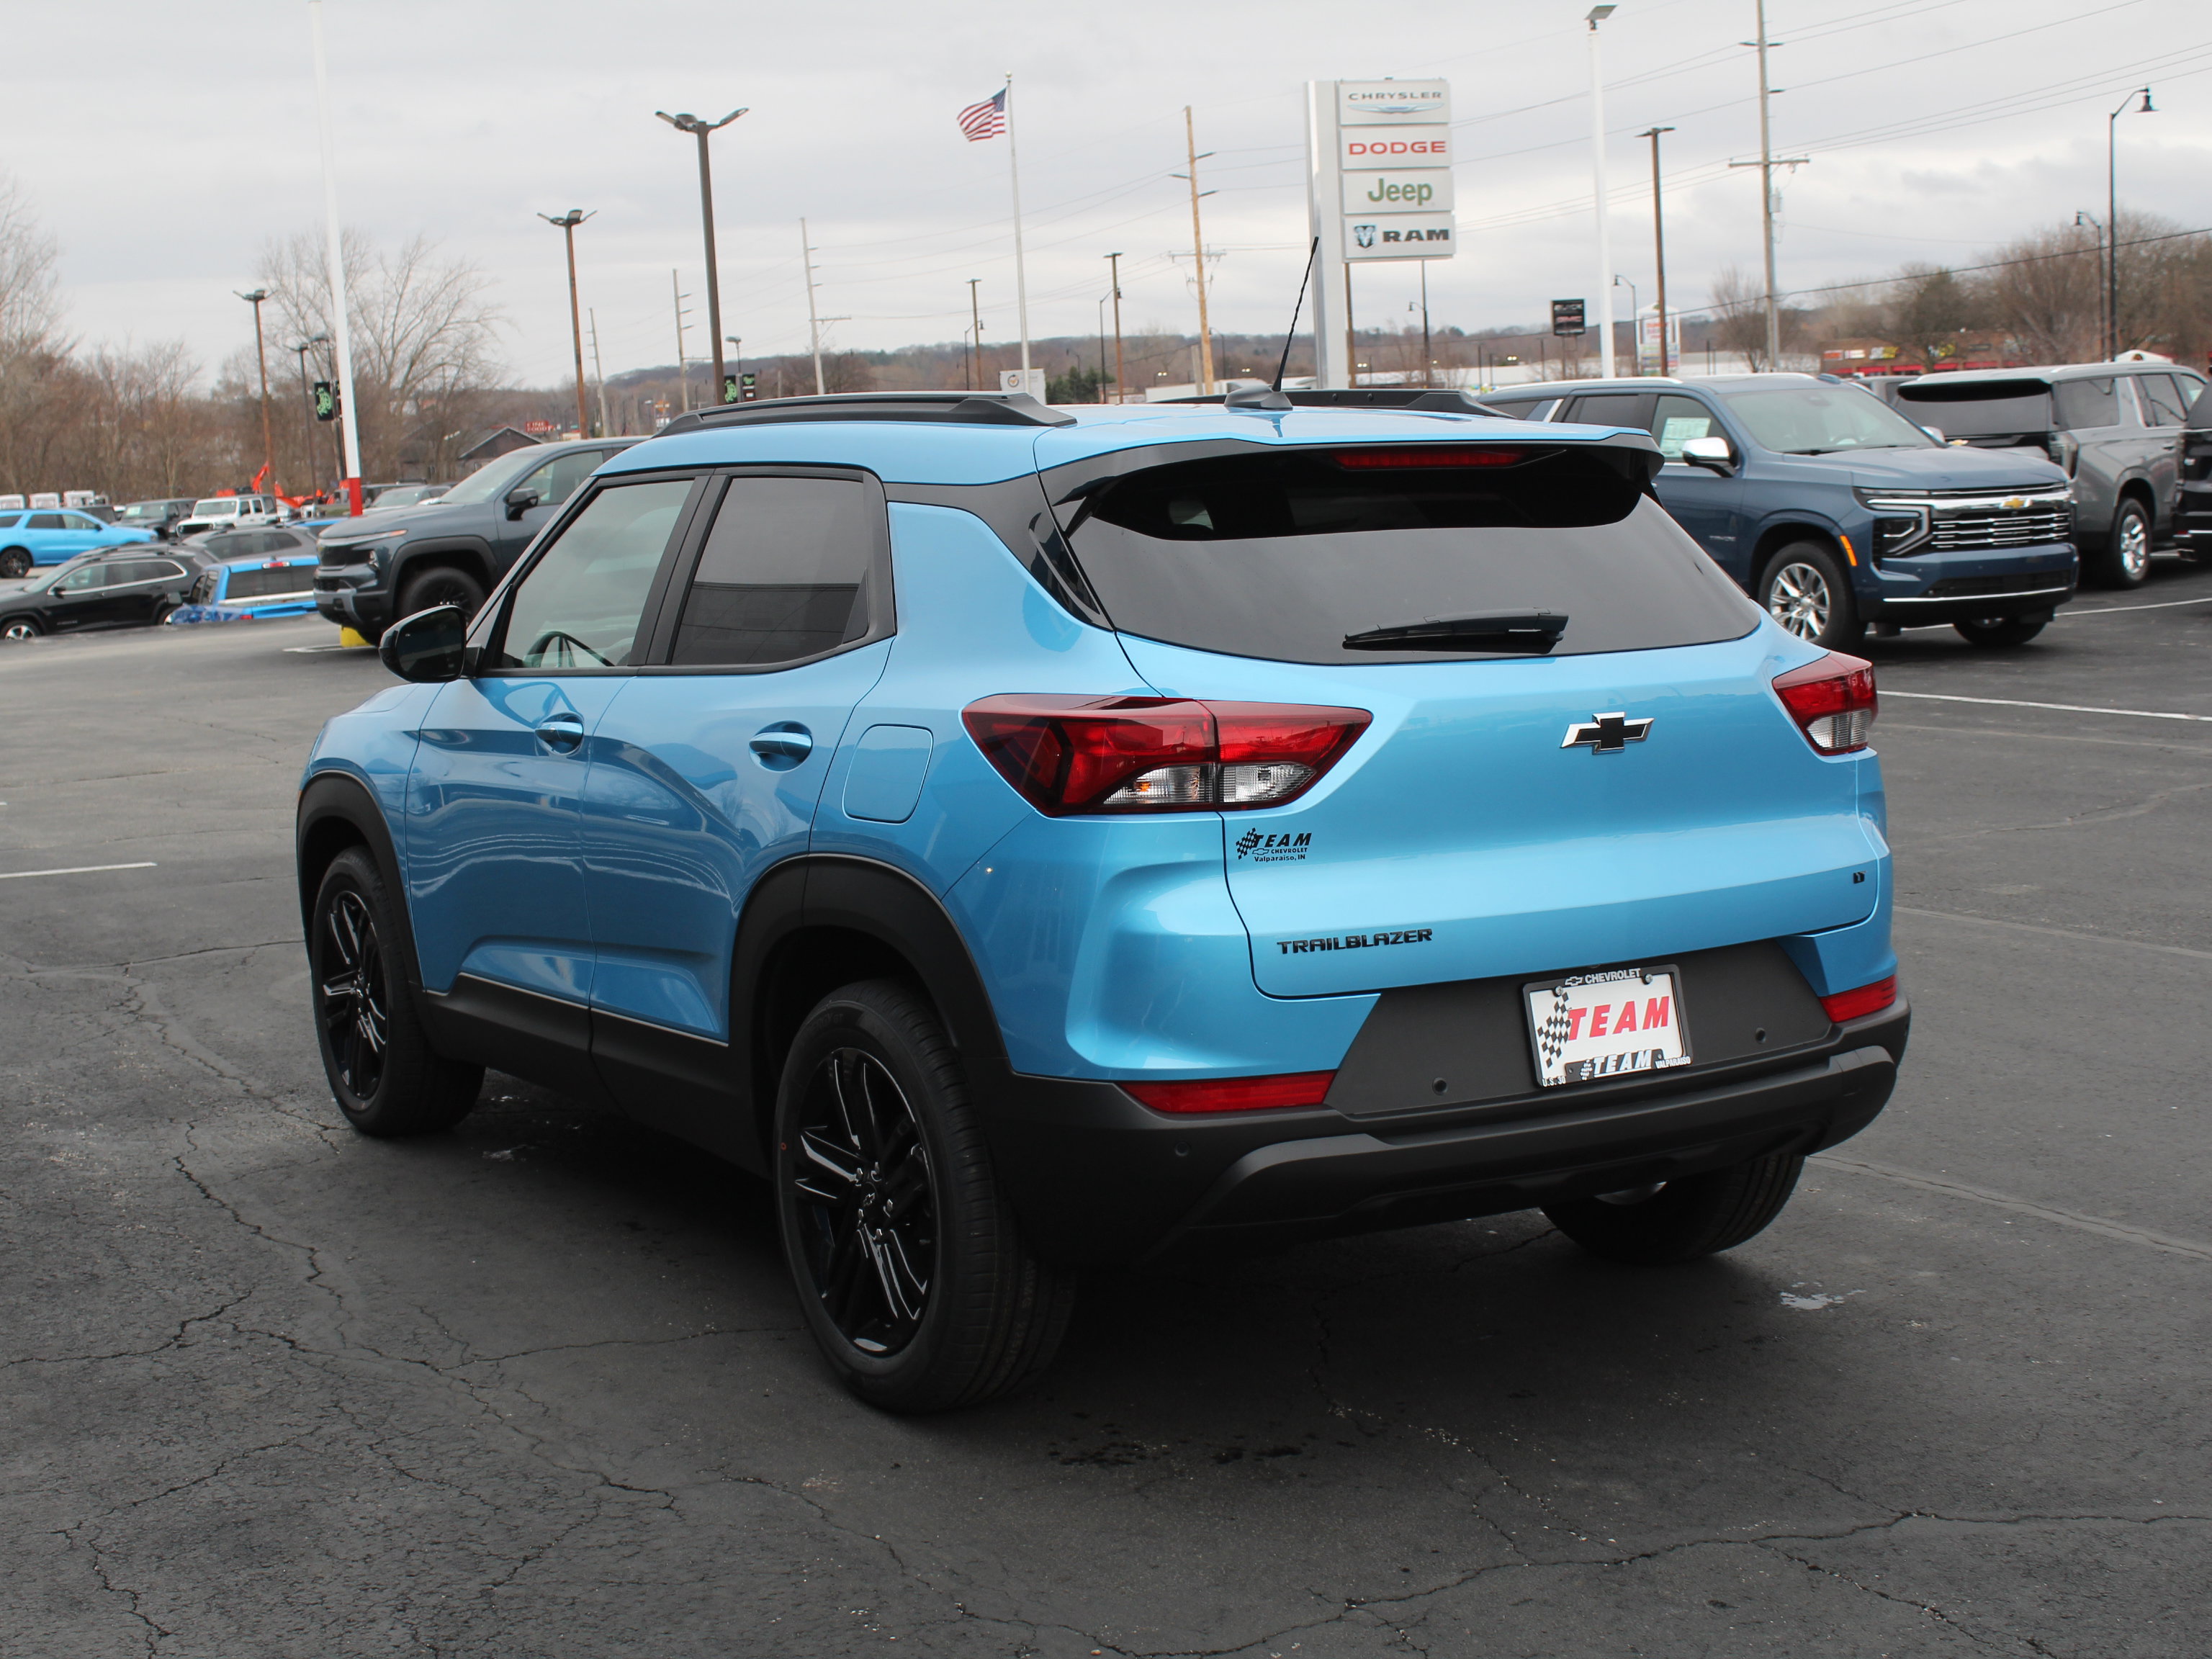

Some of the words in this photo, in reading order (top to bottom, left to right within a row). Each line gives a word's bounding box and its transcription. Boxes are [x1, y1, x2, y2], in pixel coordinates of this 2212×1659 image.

[1348, 91, 1442, 101] CHRYSLER
[1349, 141, 1447, 156] DODGE
[1367, 178, 1433, 206] Jeep
[1382, 229, 1449, 243] RAM
[1251, 832, 1312, 848] TEAM
[1277, 928, 1433, 955] TRAILBLAZER
[1585, 968, 1641, 984] CHEVROLET
[1568, 996, 1670, 1041] TEAM
[1593, 1049, 1652, 1074] TEAM
[1655, 1056, 1691, 1069] VALPARAISO
[1542, 1078, 1556, 1087] U.S.
[1556, 1076, 1566, 1086] 30
